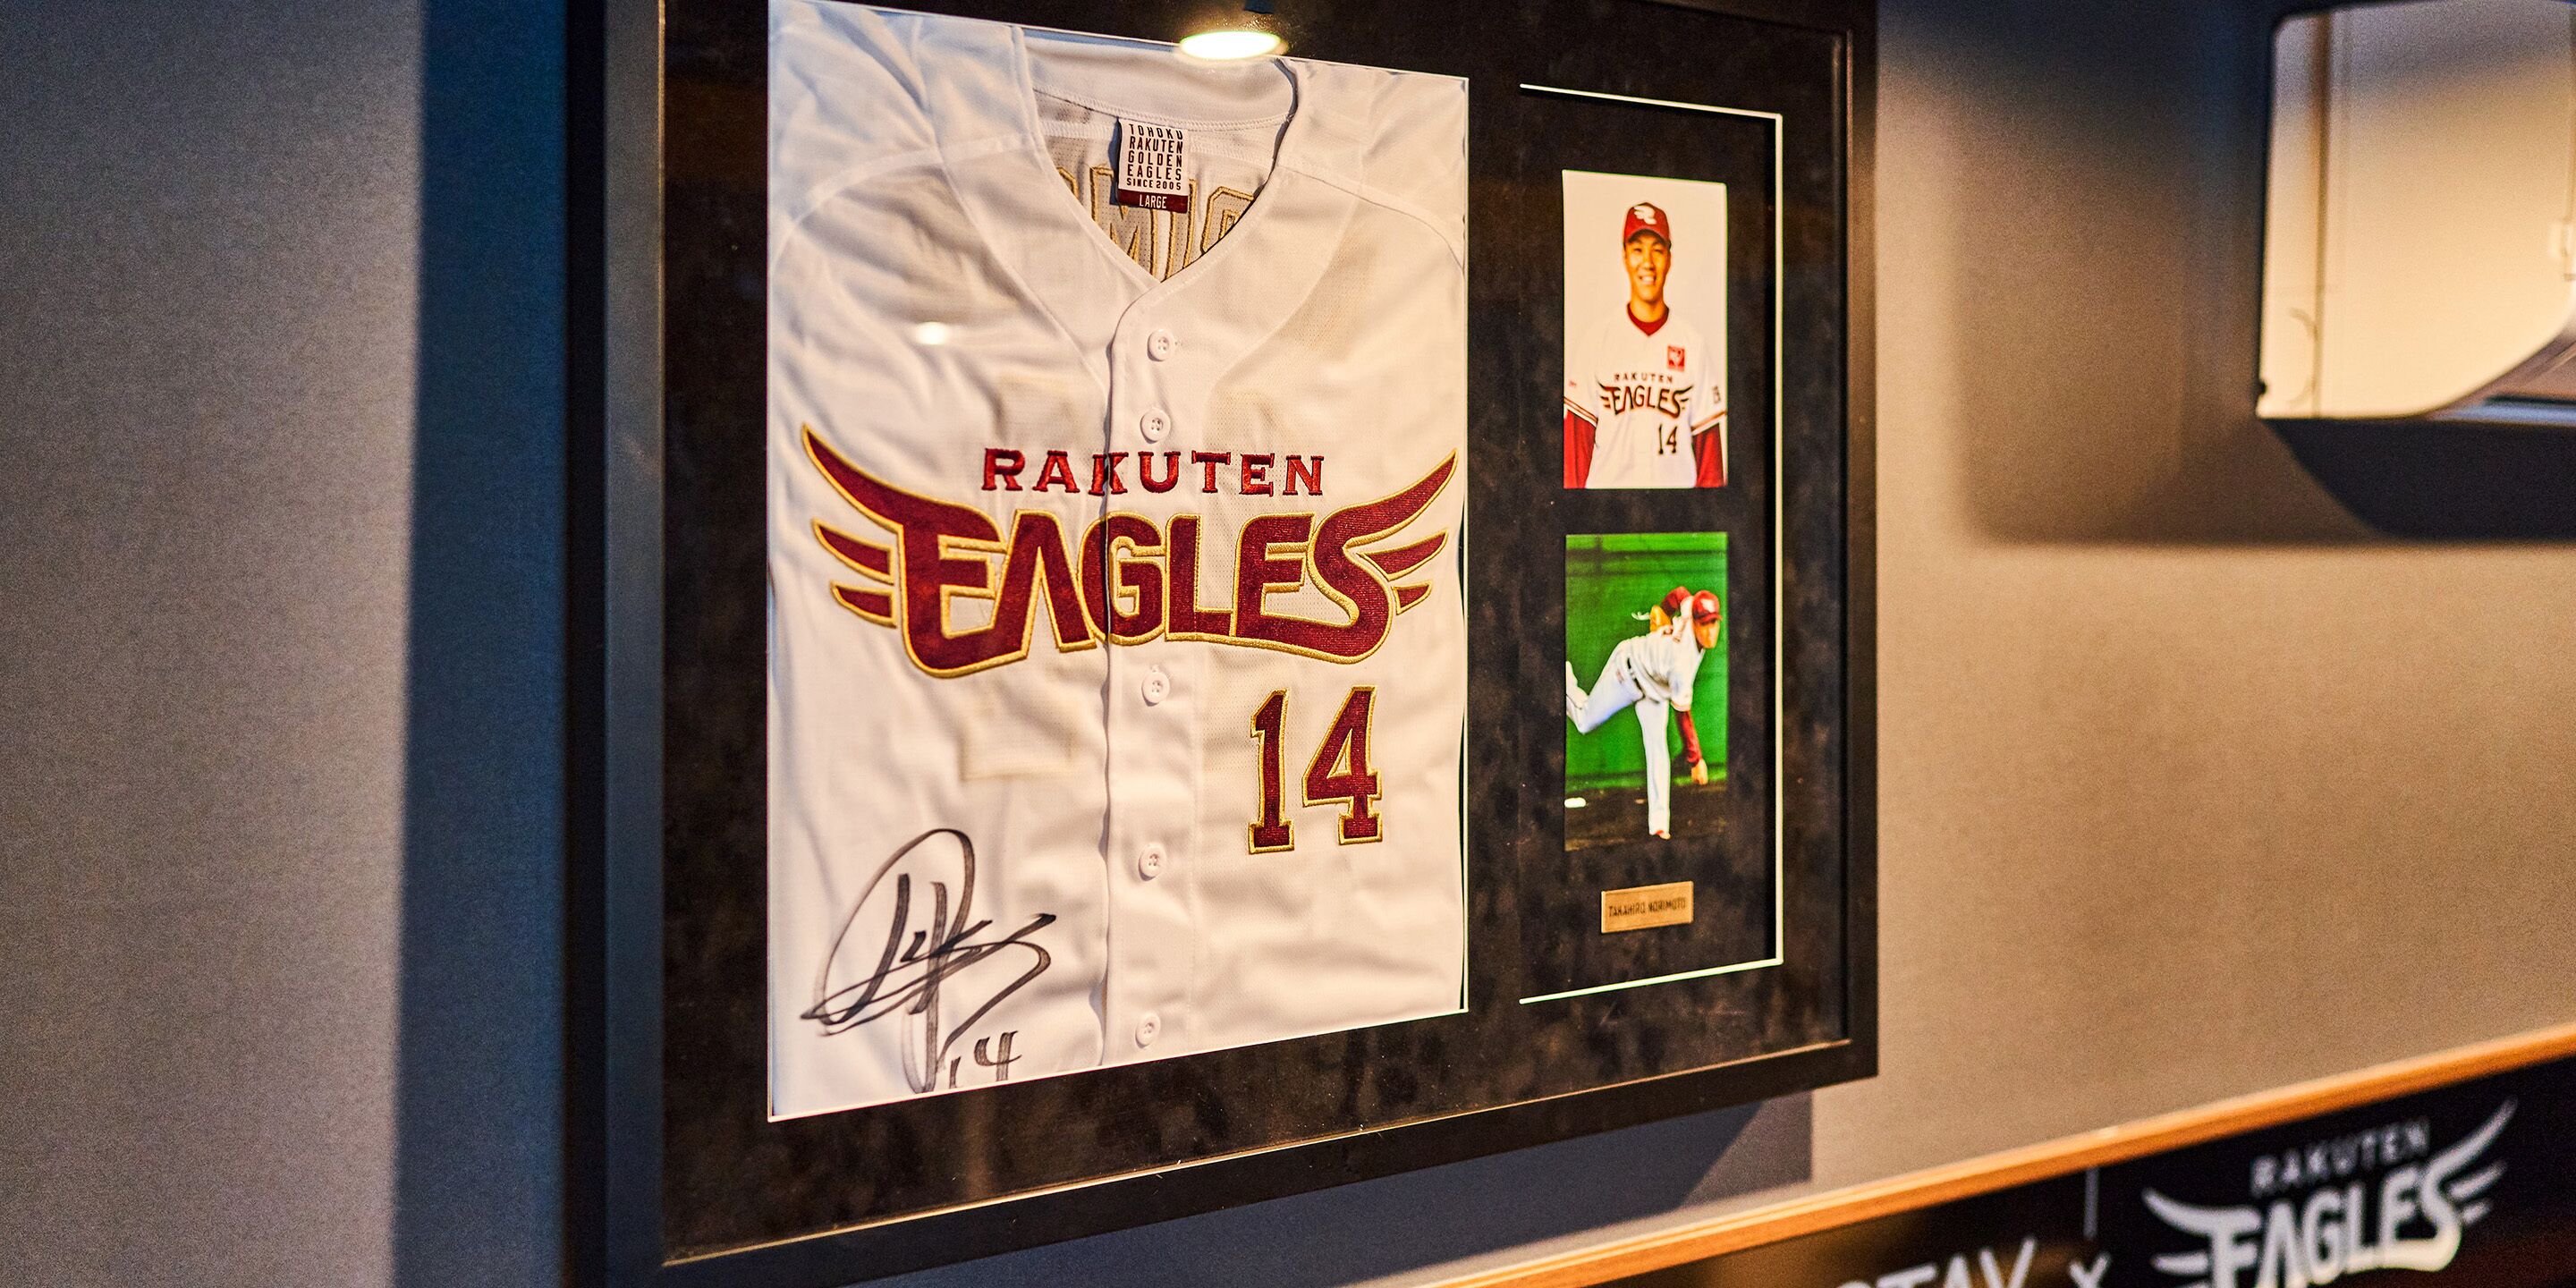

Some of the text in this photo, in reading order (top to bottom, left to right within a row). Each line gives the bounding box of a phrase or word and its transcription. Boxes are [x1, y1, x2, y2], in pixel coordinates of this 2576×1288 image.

[1129, 123, 1183, 140] TOHOKU
[1129, 136, 1183, 154] RAKUTEN
[1128, 150, 1182, 167] GOLDEN
[1126, 177, 1182, 191] SINCE 2005
[1127, 164, 1182, 181] EAGLES
[1139, 194, 1167, 209] LARGE
[1614, 372, 1673, 383] RAKUTEN
[1596, 379, 1693, 419] EAGLES
[1658, 423, 1678, 454] 14
[981, 448, 1325, 496] RAKUTEN
[802, 423, 1457, 679] EAGLES
[1248, 685, 1383, 854] 14
[1608, 901, 1646, 918] TAKAHIRO
[948, 1030, 1022, 1089] 14
[2251, 1119, 2430, 1197] RAKUTEN
[2143, 1099, 2517, 1288] EAGLES
